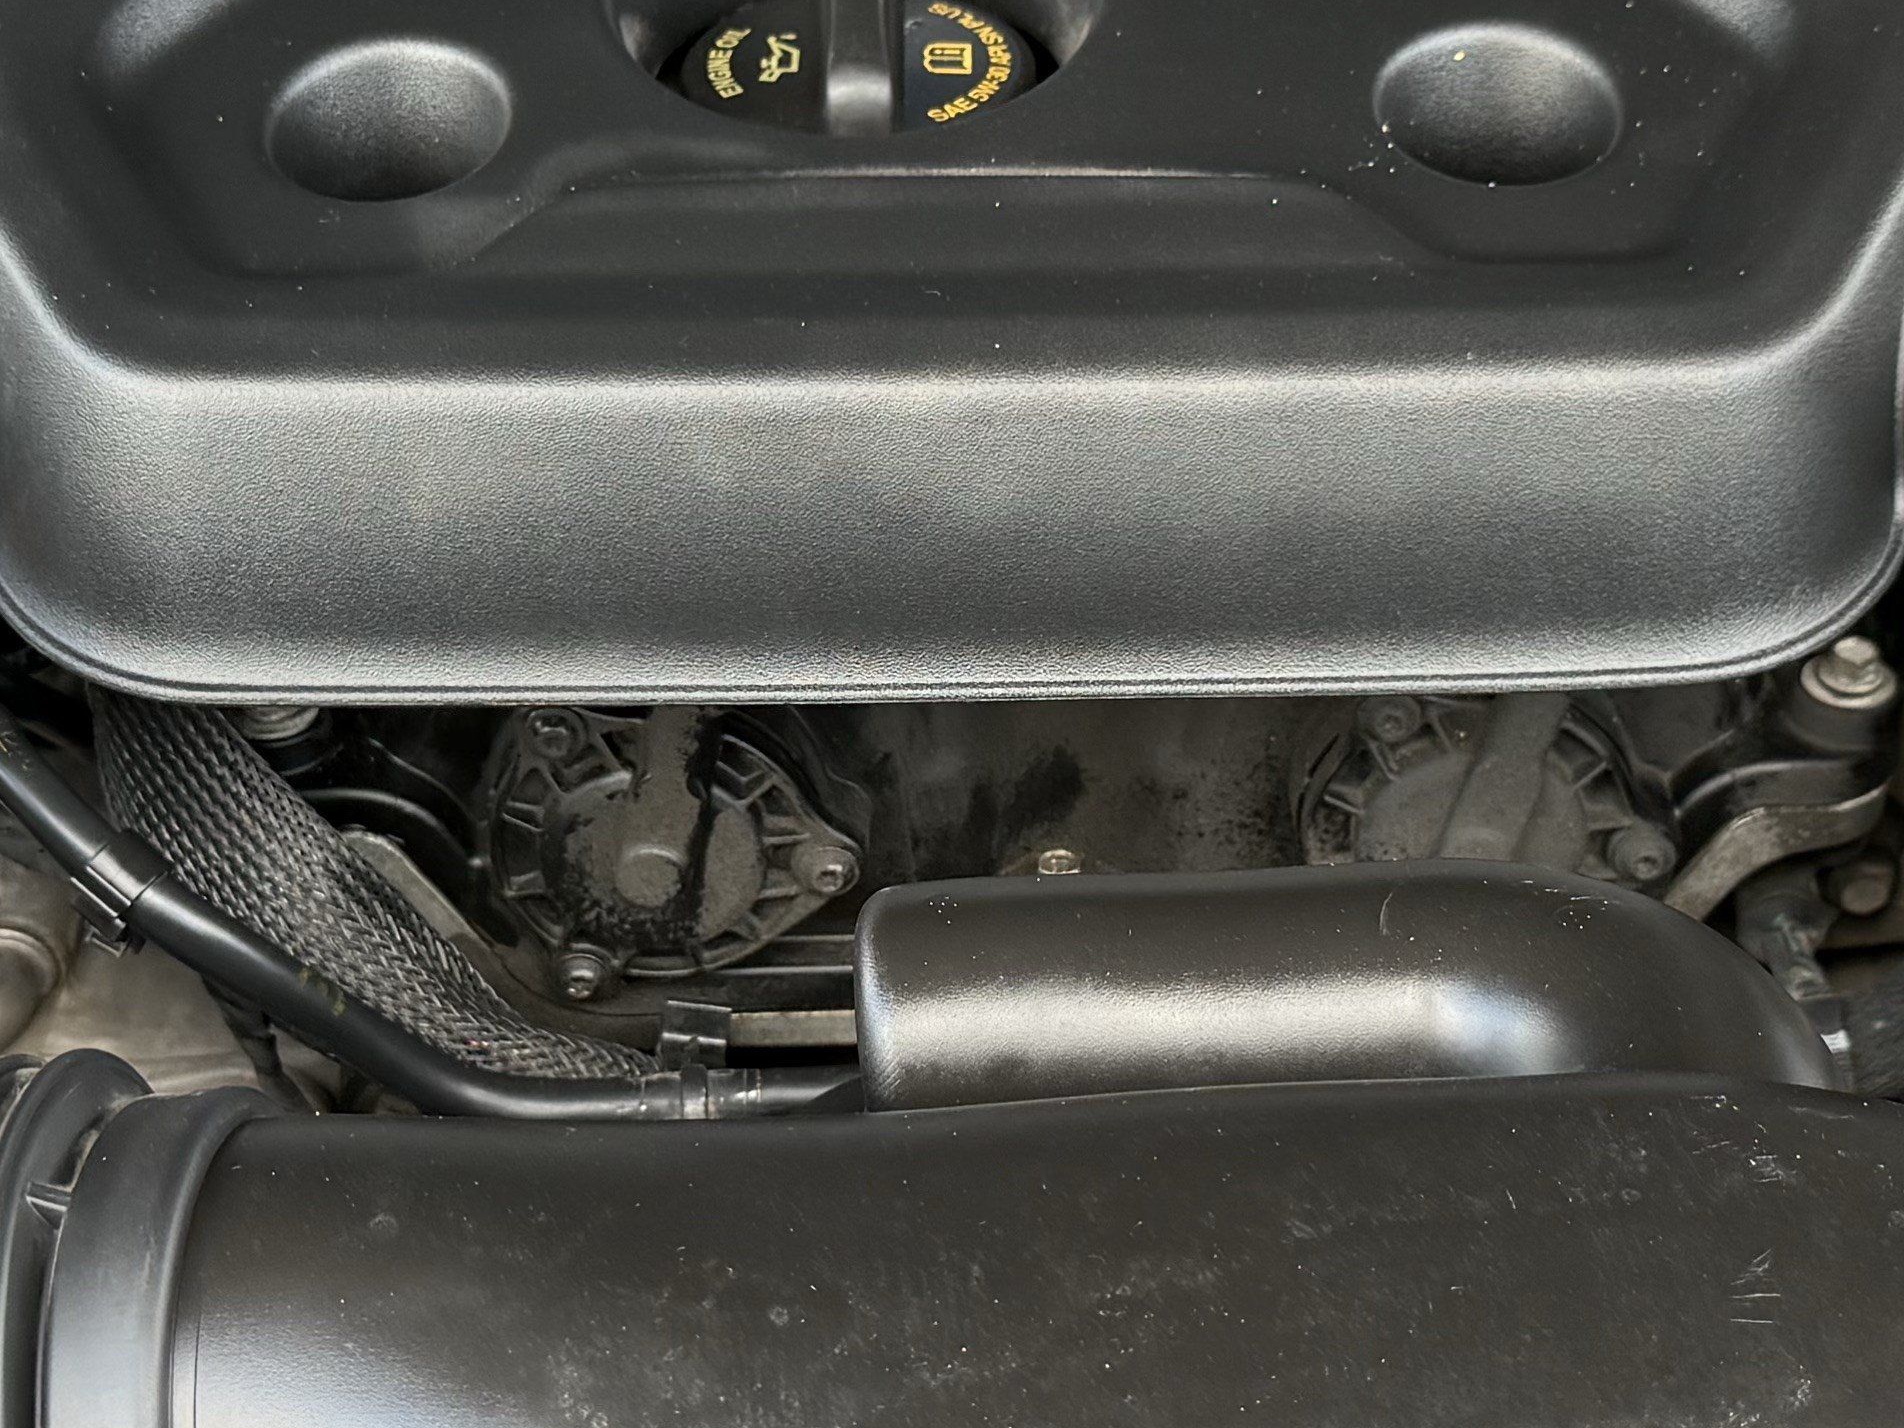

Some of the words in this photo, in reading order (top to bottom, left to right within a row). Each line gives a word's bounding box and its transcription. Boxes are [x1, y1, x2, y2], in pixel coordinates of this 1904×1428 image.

[715, 28, 751, 50] OIL
[706, 48, 744, 99] ENGINE
[927, 98, 979, 123] SAE
[973, 66, 1011, 102] 5W-30
